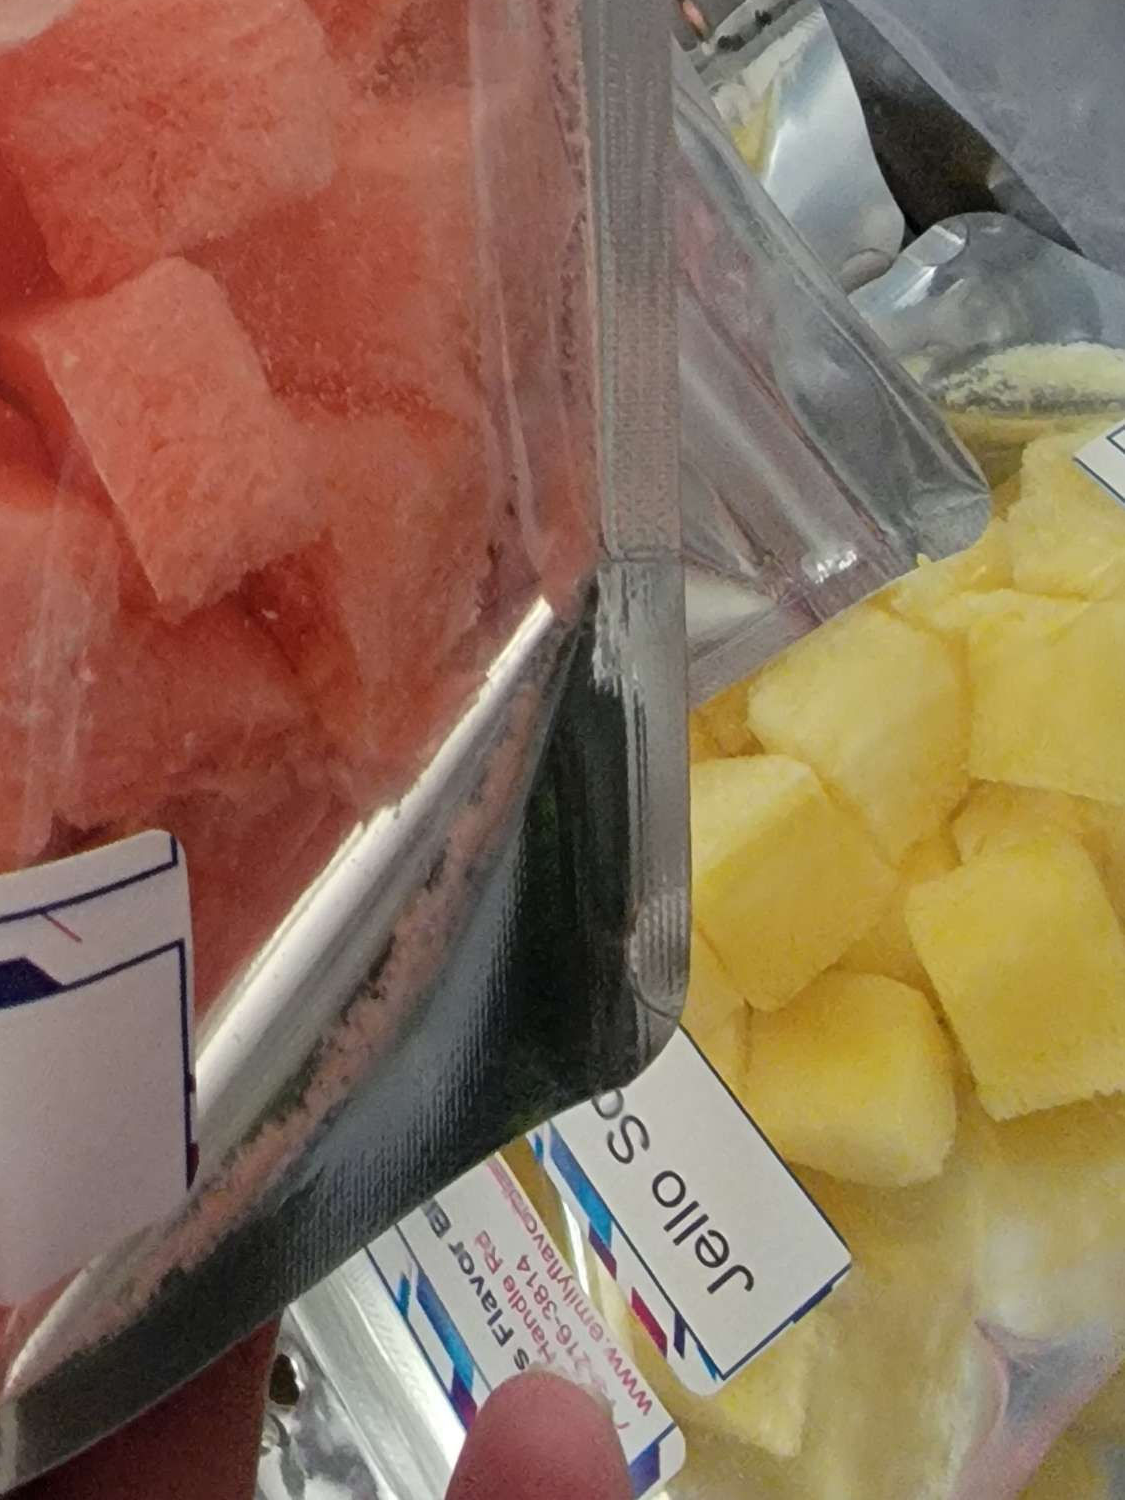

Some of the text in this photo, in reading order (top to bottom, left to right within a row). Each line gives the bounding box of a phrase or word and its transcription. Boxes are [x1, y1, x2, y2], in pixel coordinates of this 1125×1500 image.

[474, 1230, 504, 1275] Rd
[652, 1169, 755, 1295] Jello
[448, 1241, 515, 1348] Flavor
[502, 1274, 557, 1365] Handle
